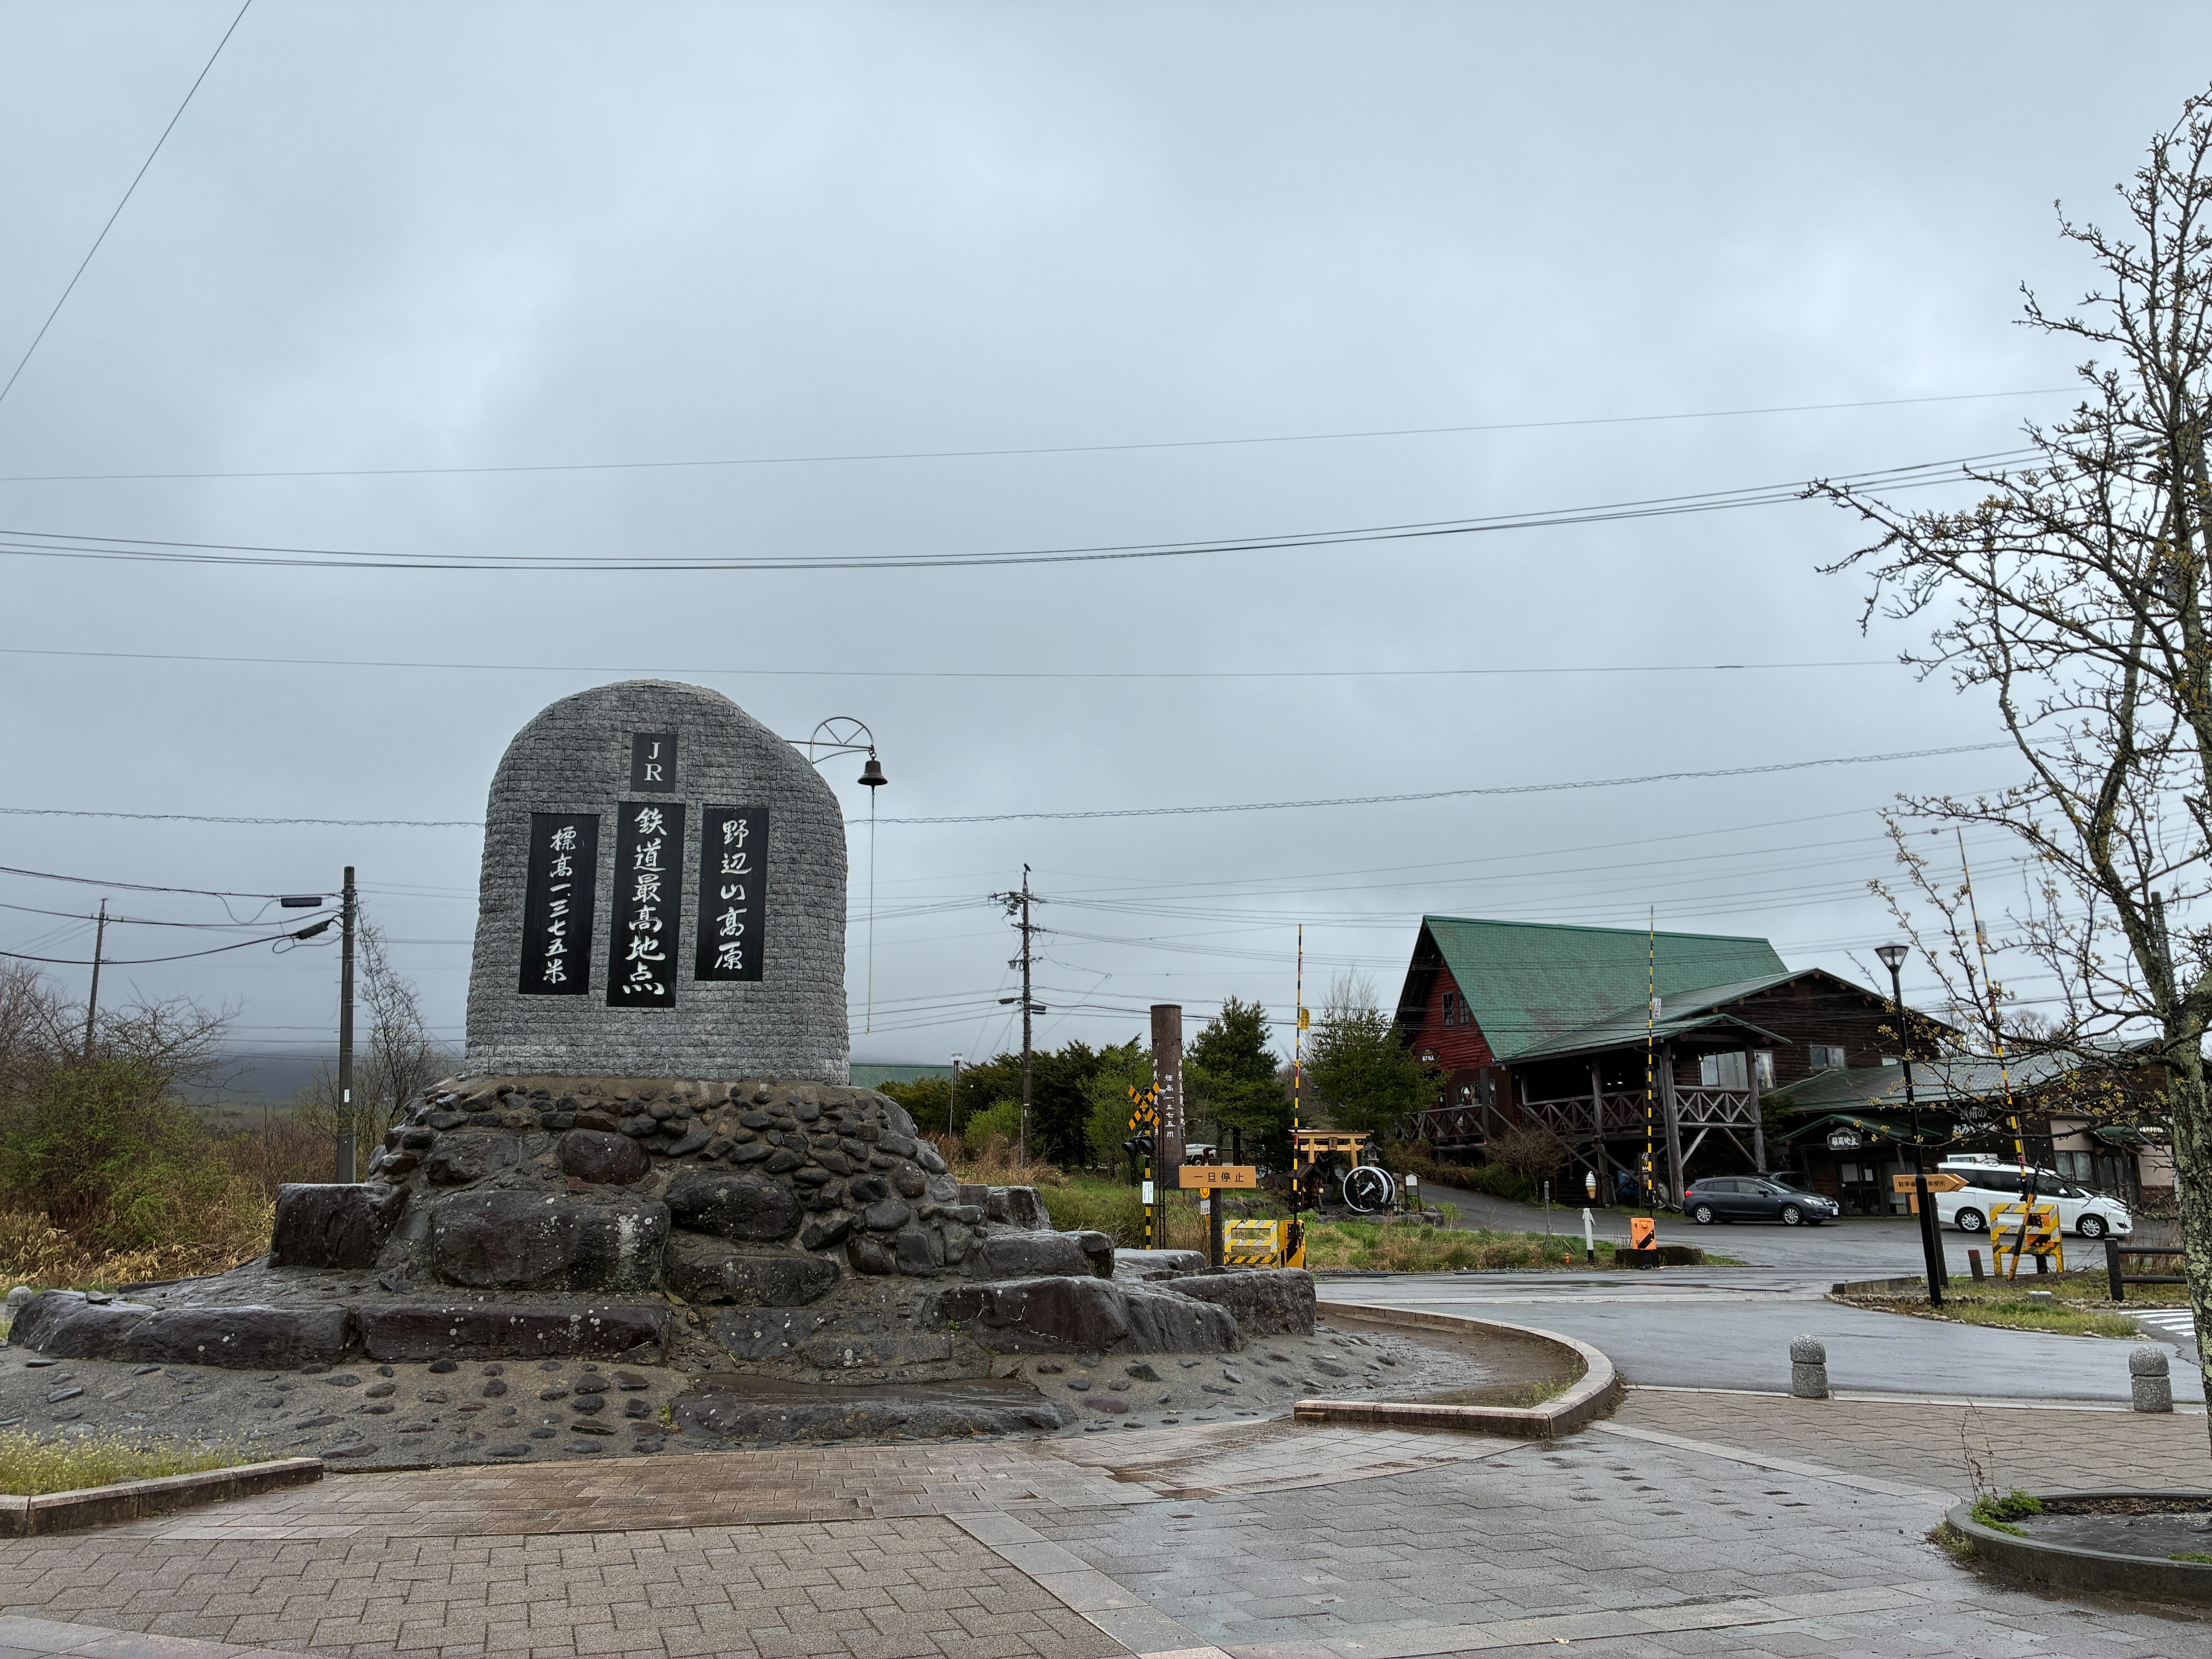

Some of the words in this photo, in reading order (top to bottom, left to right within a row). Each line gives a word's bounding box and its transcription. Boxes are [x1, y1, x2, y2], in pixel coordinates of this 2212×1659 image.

[644, 742, 663, 781] JR
[622, 806, 667, 996] 鉄道最高地点
[714, 819, 752, 971] 野辺山高原
[1194, 1172, 1244, 1182] 一旦停止
